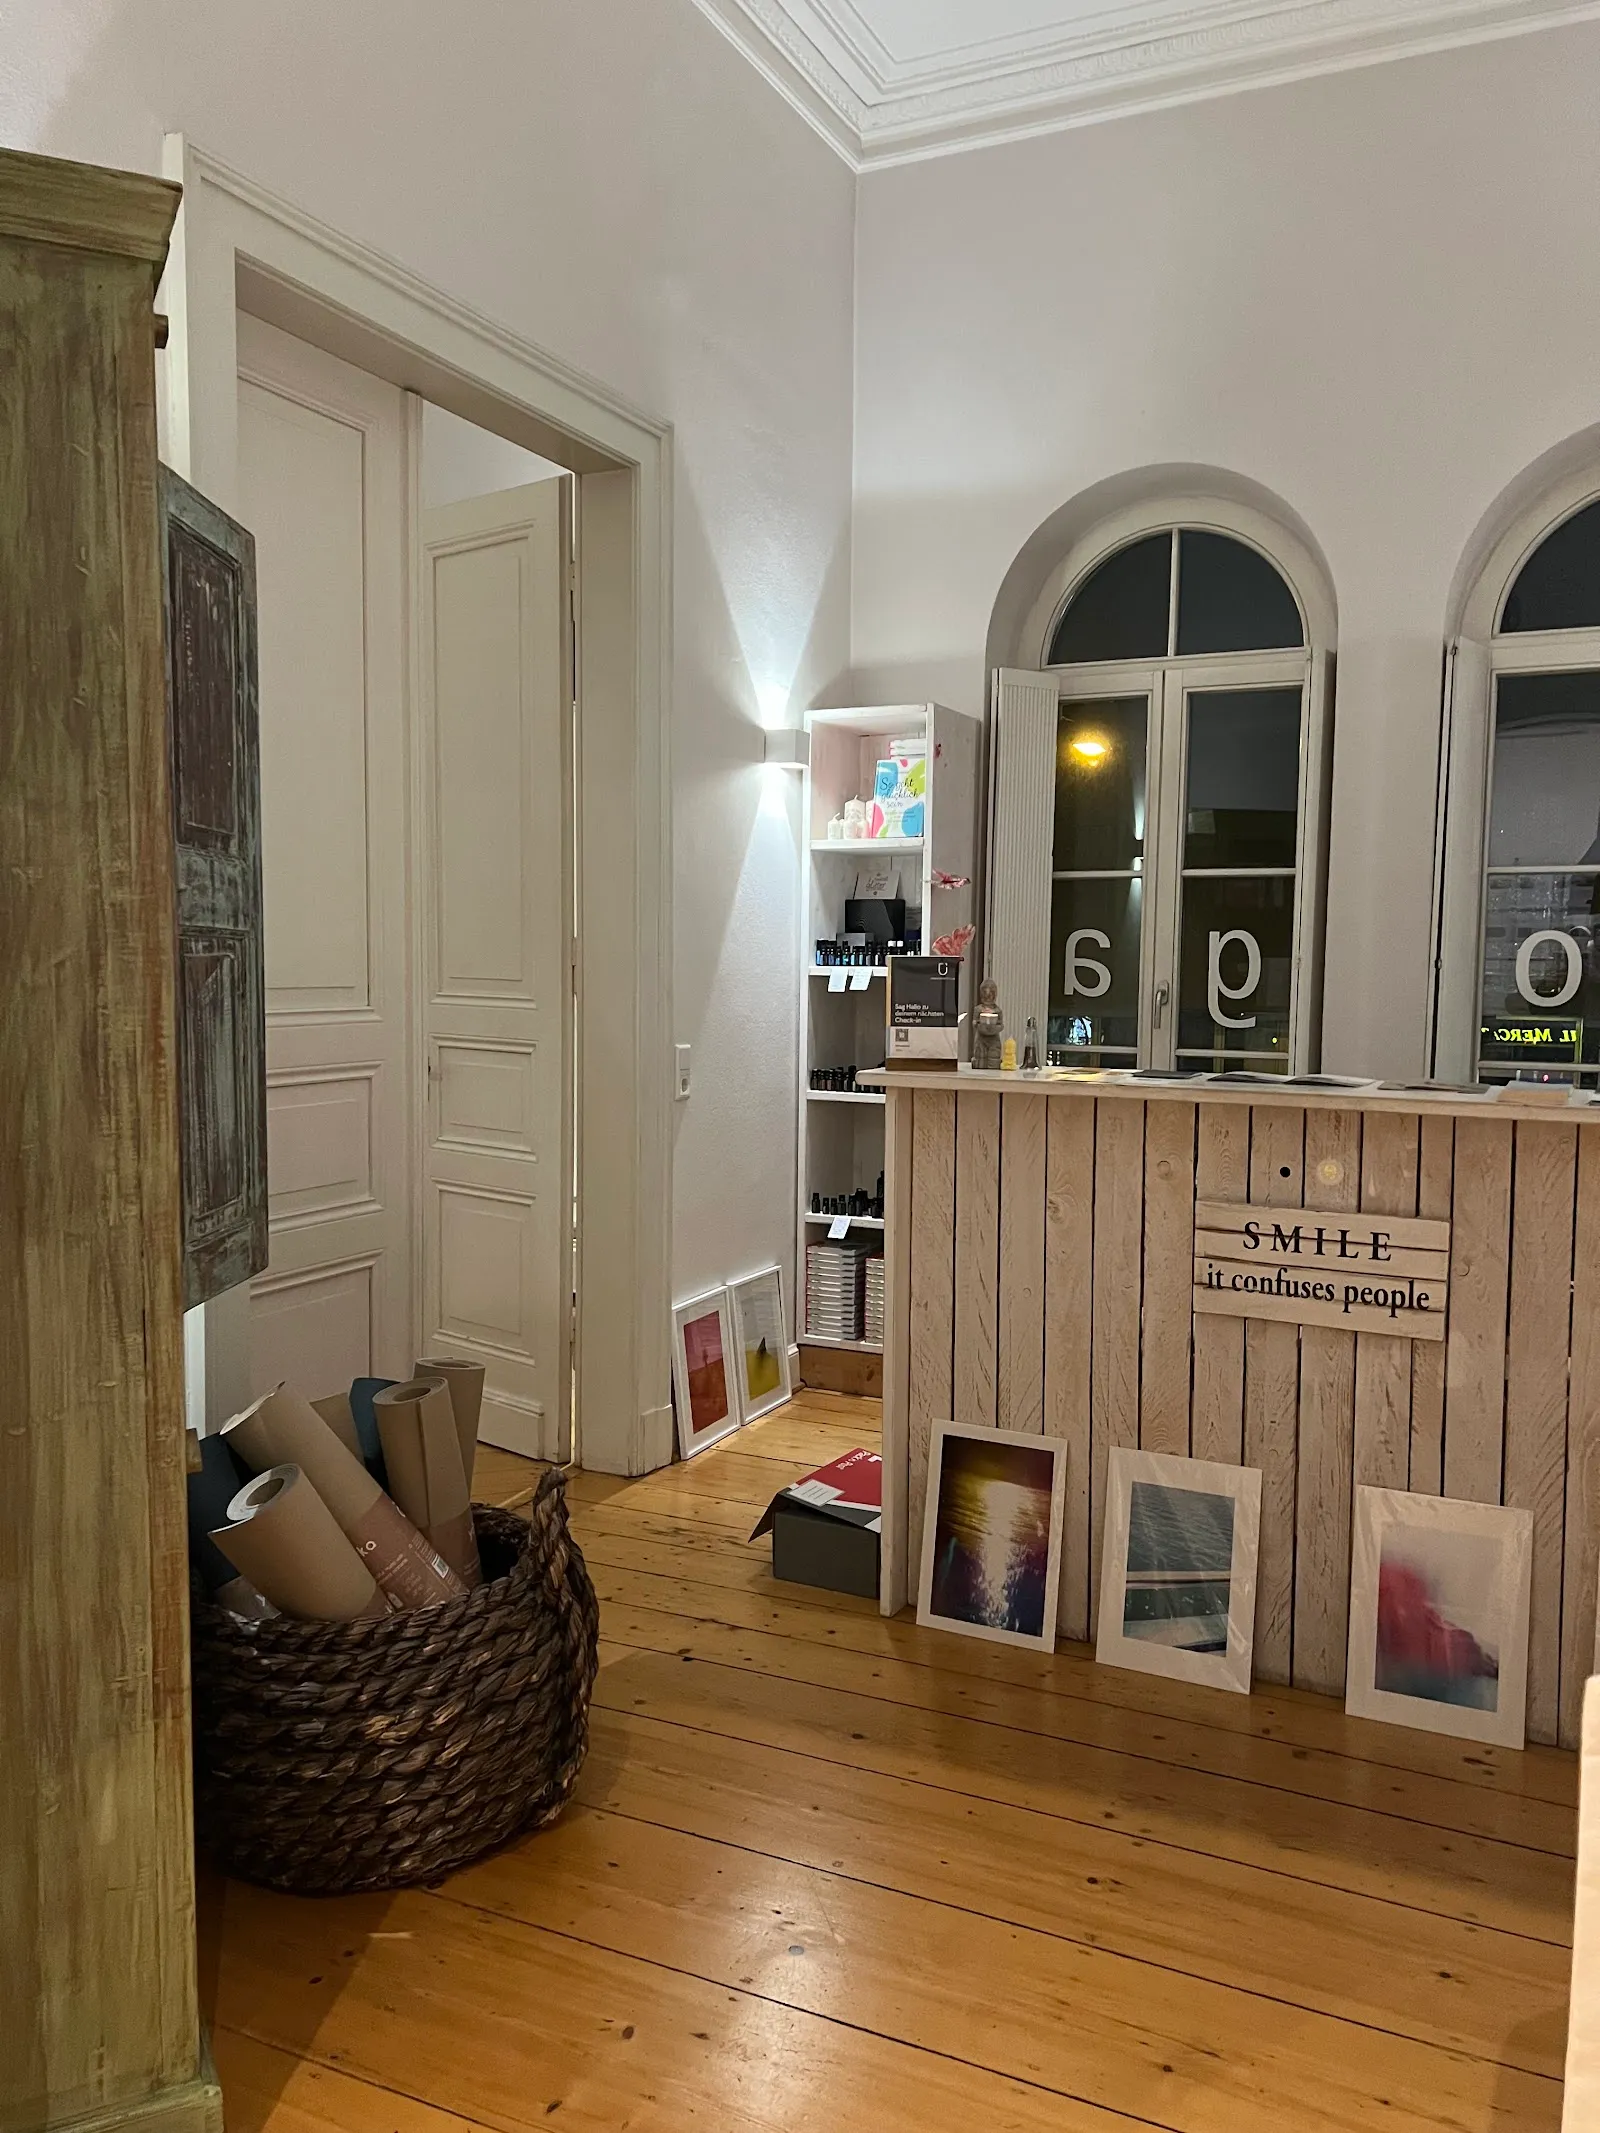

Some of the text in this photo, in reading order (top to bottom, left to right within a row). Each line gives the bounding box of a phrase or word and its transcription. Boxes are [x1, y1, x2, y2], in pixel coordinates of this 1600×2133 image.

[895, 1003, 906, 1012] Sag
[1242, 1221, 1392, 1262] SMILE
[1206, 1263, 1430, 1319] it confuses people
